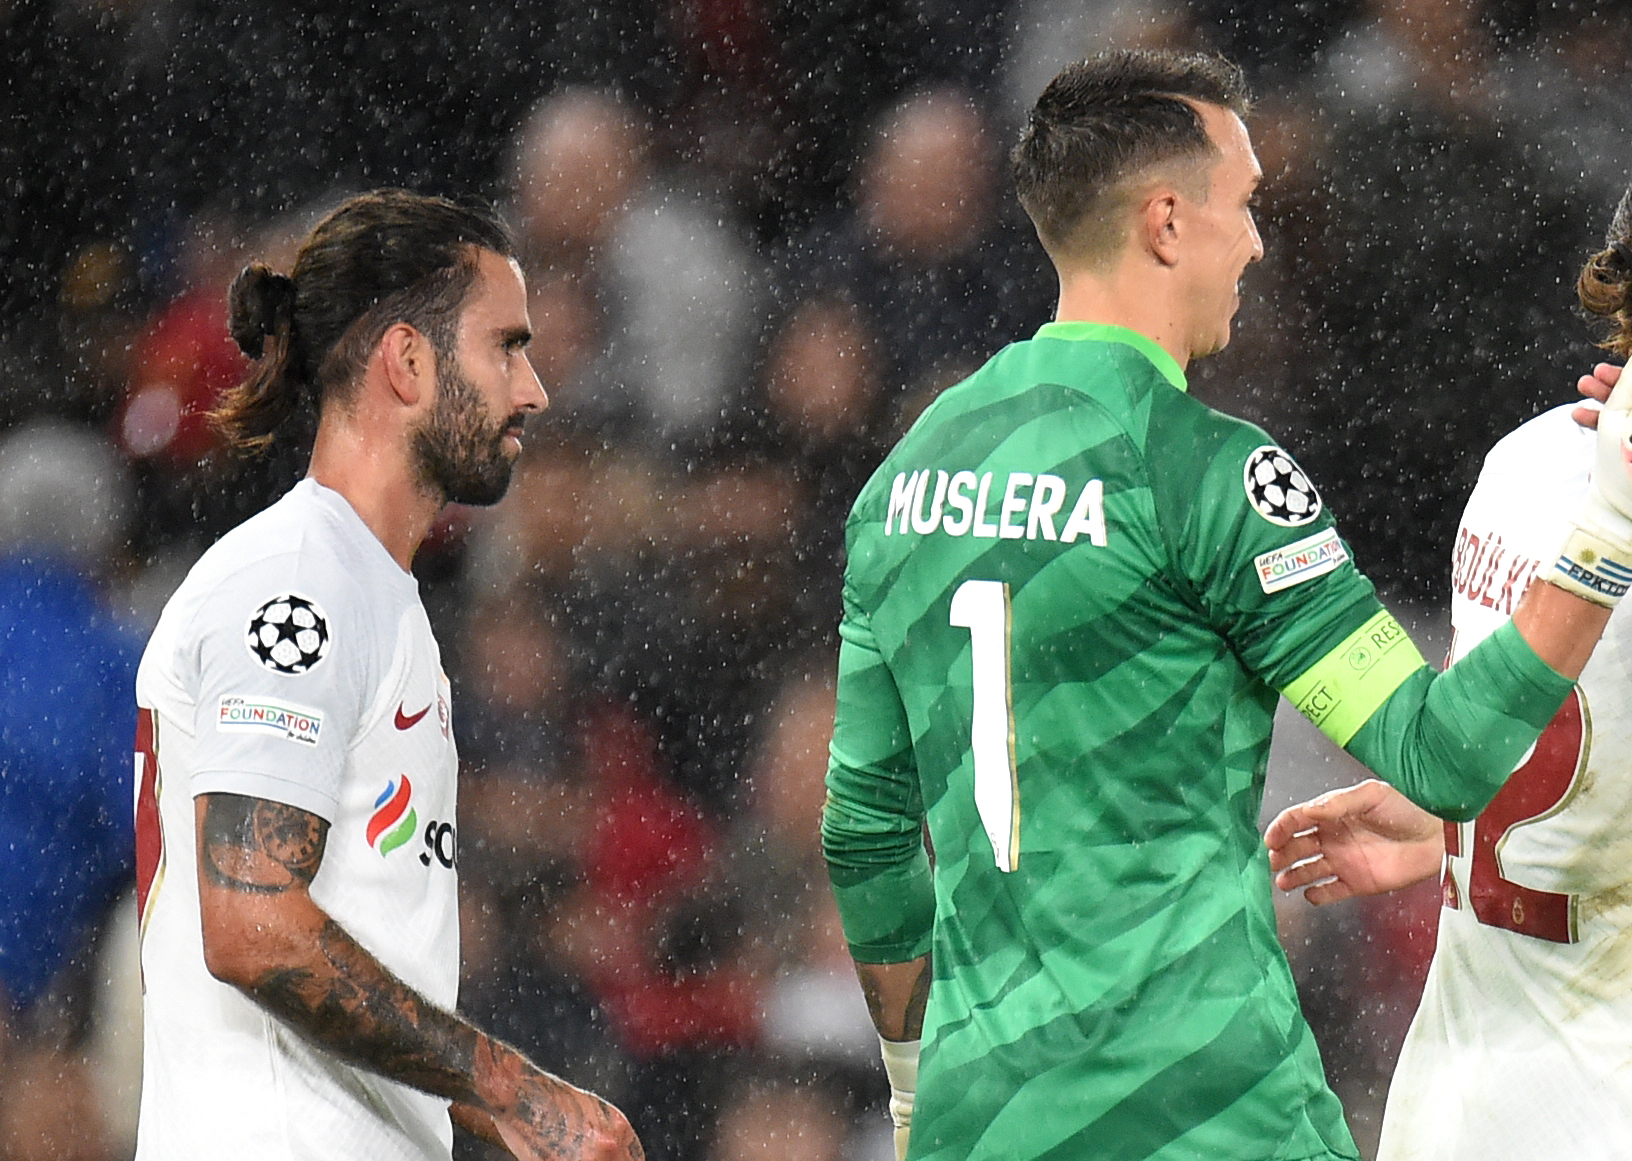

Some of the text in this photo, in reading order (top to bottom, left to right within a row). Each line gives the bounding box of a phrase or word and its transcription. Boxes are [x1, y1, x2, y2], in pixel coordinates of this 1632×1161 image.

[884, 468, 1108, 548] MUSLERA
[1371, 620, 1401, 649] RES
[220, 706, 321, 736] FOUNDATION
[949, 579, 1021, 873] 1
[418, 820, 457, 869] SO
